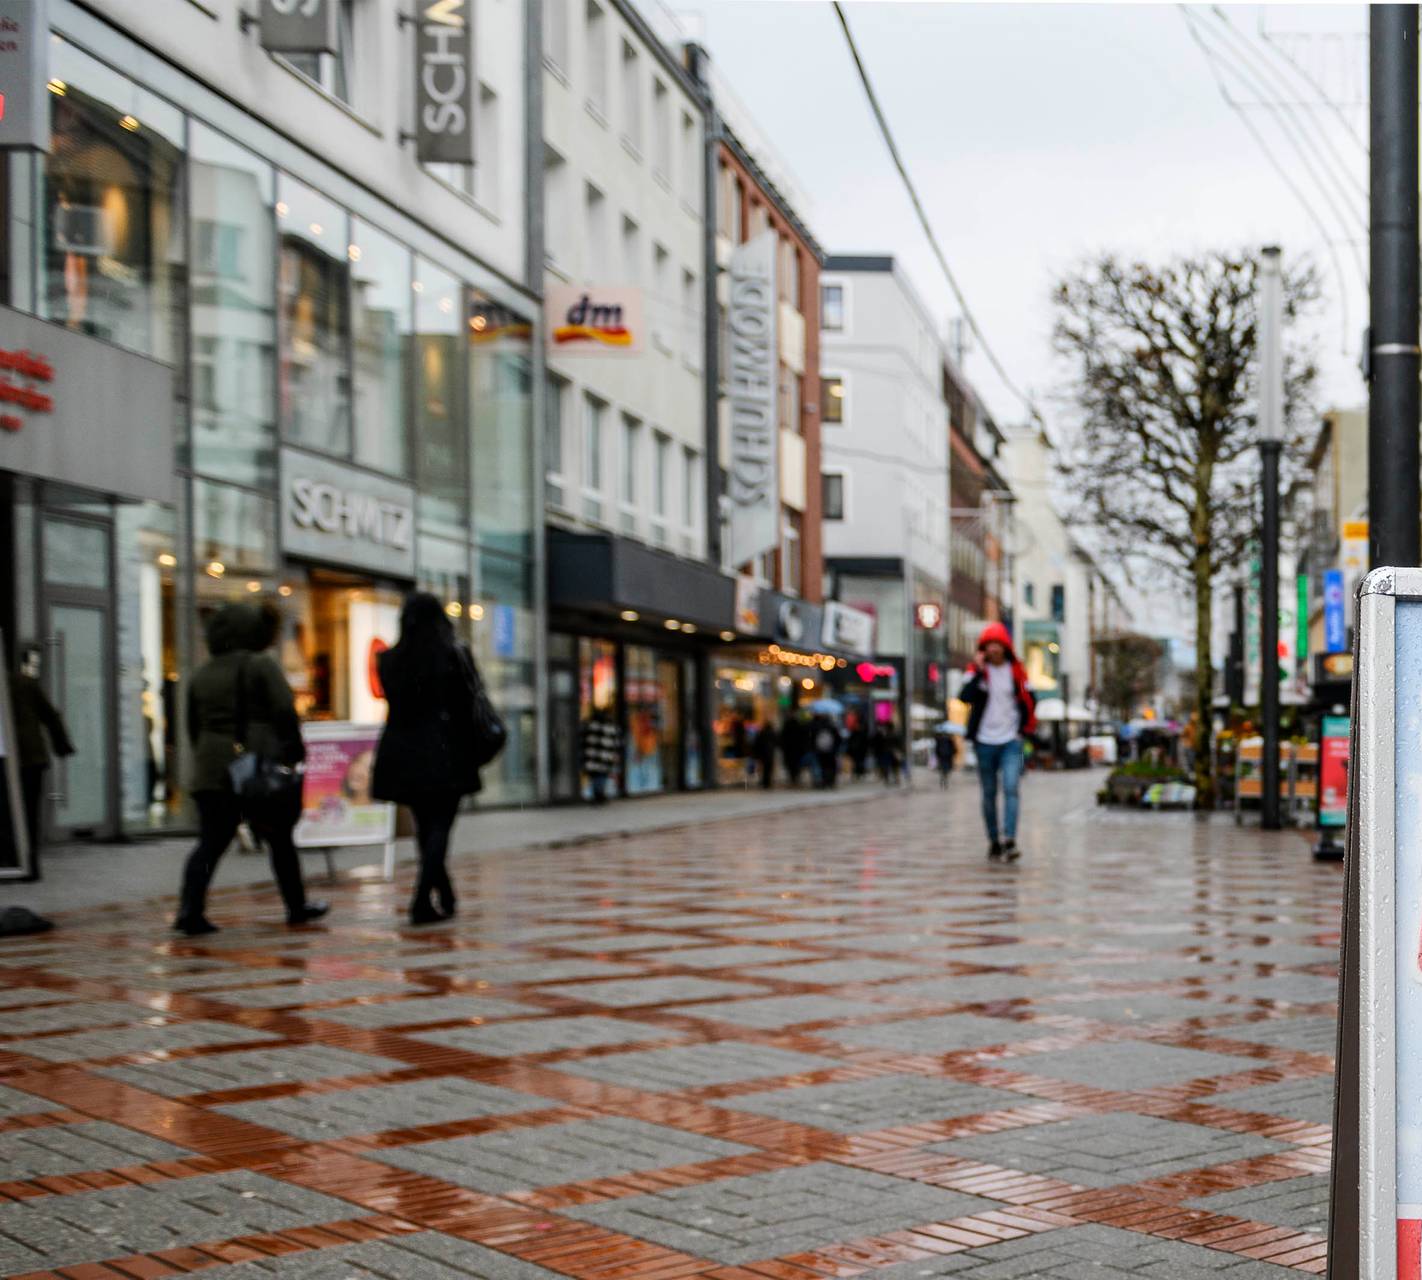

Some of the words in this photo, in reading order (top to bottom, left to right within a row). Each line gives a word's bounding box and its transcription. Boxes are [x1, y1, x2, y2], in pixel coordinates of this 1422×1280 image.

[566, 293, 622, 326] dm
[729, 258, 770, 506] SCHUHMODE
[290, 479, 413, 551] SCHMITZ
